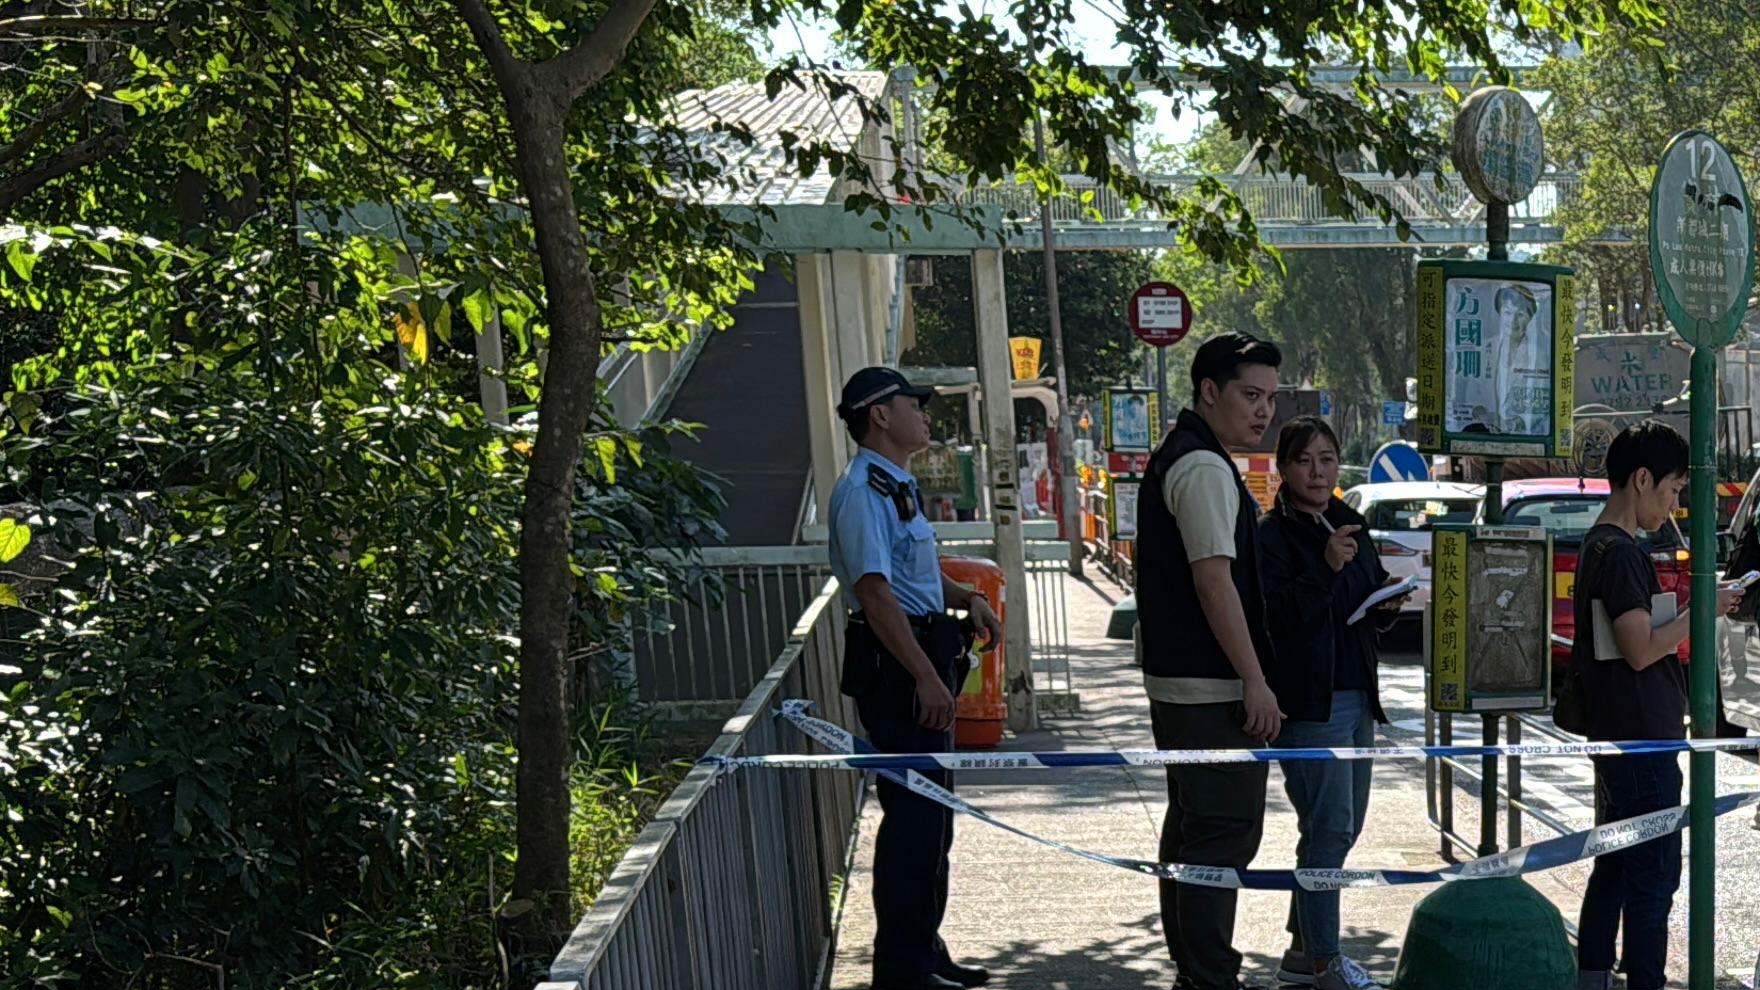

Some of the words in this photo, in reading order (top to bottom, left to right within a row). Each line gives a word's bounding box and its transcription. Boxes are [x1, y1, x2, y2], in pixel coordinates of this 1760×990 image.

[1685, 139, 1717, 181] 12
[1421, 271, 1438, 411] 可指定派送日期
[1591, 373, 1673, 394] WATER
[1441, 537, 1459, 675] 最快今發明到
[1299, 870, 1333, 878] POLICE
